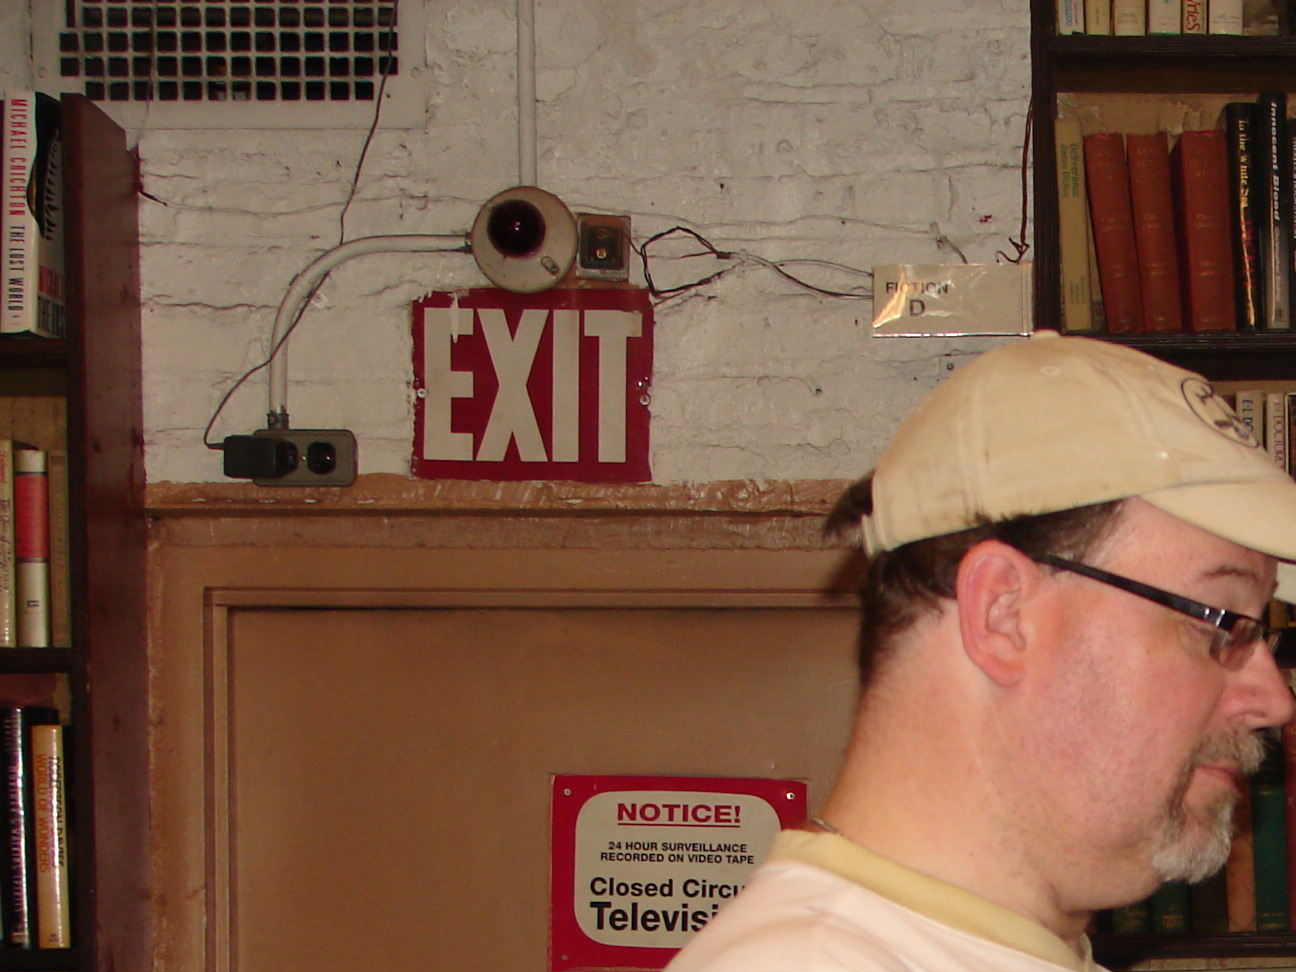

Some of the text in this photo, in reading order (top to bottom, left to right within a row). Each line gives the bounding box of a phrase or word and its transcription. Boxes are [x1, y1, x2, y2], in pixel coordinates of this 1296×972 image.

[1270, 101, 1282, 221] Innocent Blood
[7, 98, 29, 312] MICHAEL CRICHTON THE LOST WORLD
[885, 281, 948, 295] FICTION
[908, 299, 926, 317] D
[423, 307, 643, 463] EXIT
[35, 753, 52, 874] WORLD OF WONDERS
[616, 803, 742, 823] NOTICE!
[607, 841, 748, 854] 24 HOUR SURVEILLANCE
[600, 852, 755, 865] RECORDED ON VIDEO TAPE
[589, 877, 674, 897] Closed
